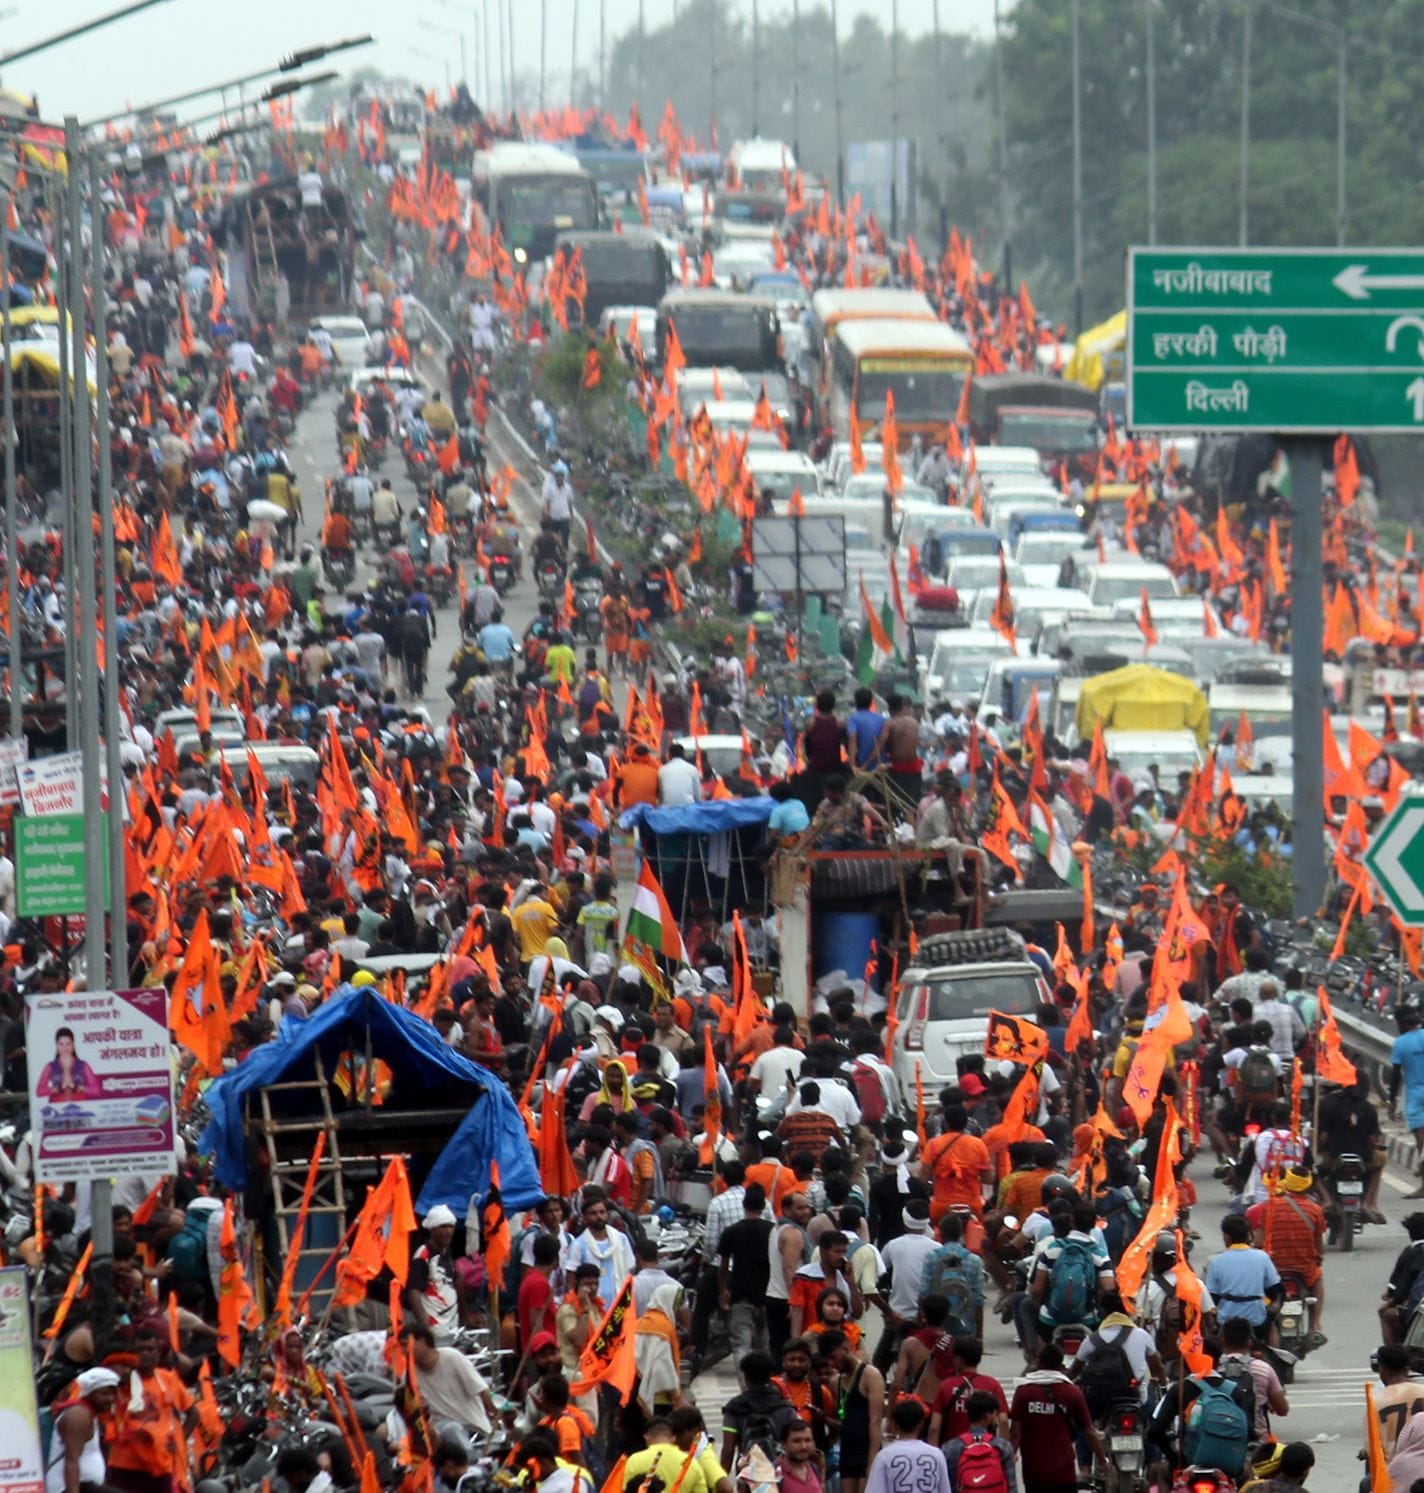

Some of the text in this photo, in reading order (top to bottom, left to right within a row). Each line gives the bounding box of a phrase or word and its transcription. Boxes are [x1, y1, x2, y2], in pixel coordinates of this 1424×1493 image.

[1152, 324, 1218, 359] हरकी
[1185, 379, 1249, 412] दिल्ली
[83, 1027, 142, 1044] आपकी यात्रा
[99, 1045, 147, 1061] मंगलमय
[890, 1454, 938, 1493] 23
